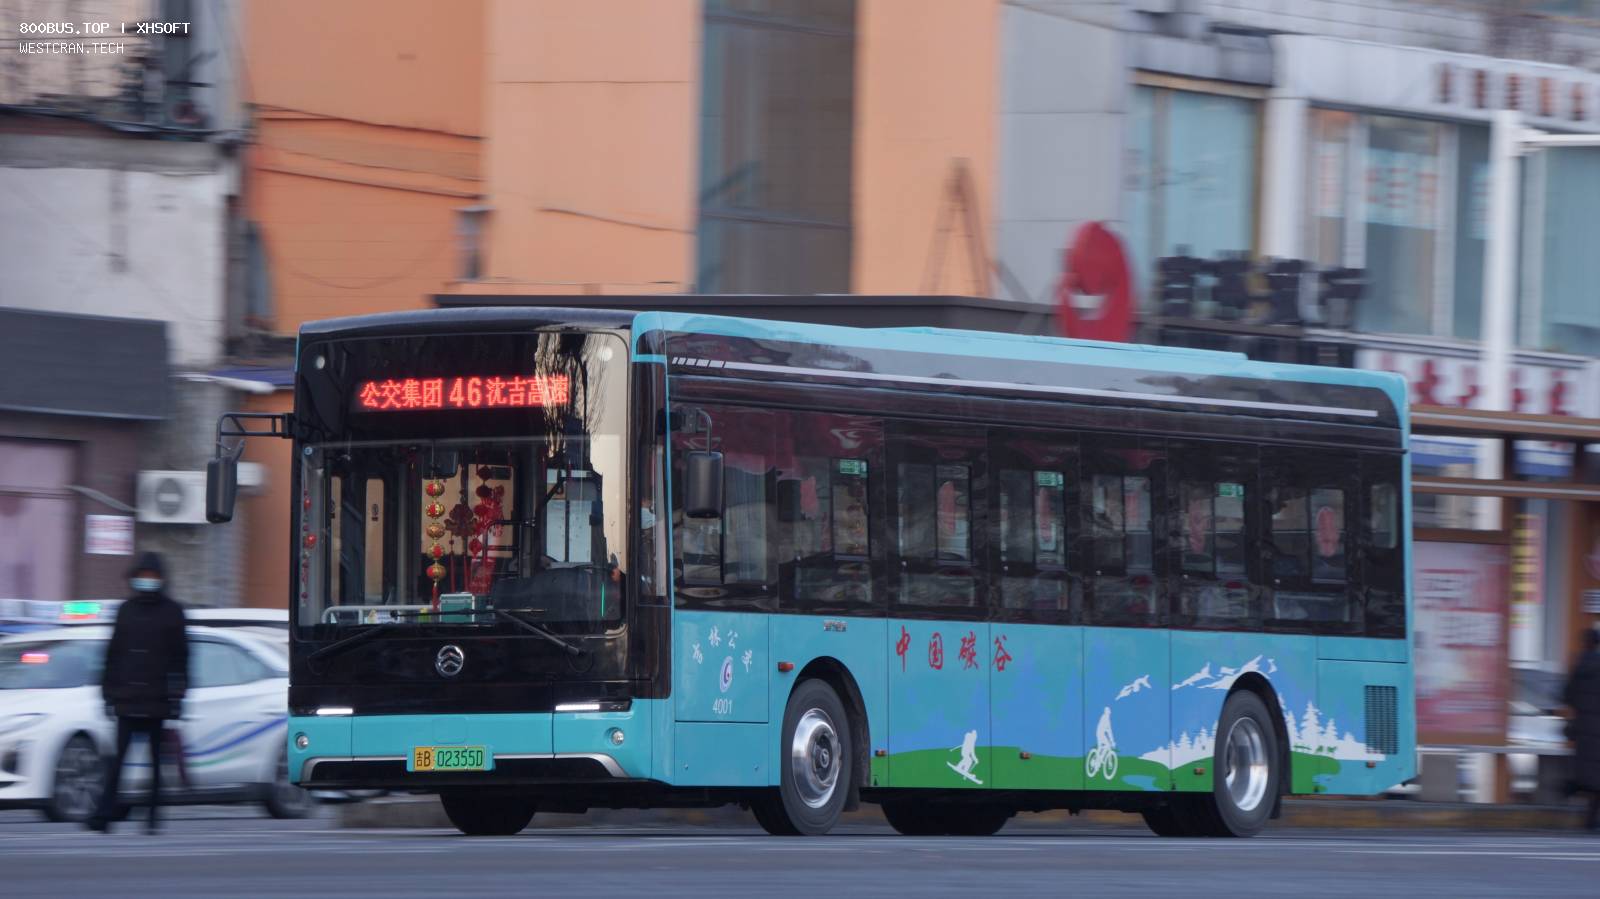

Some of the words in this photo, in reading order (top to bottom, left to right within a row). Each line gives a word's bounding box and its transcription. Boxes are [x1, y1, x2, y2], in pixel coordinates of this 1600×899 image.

[360, 378, 443, 409] 公交集团
[449, 376, 482, 407] 46
[486, 373, 569, 406] 沈吉高速
[895, 624, 1013, 673] 中国碳谷
[712, 698, 733, 715] 4001
[437, 750, 483, 767] 02355D
